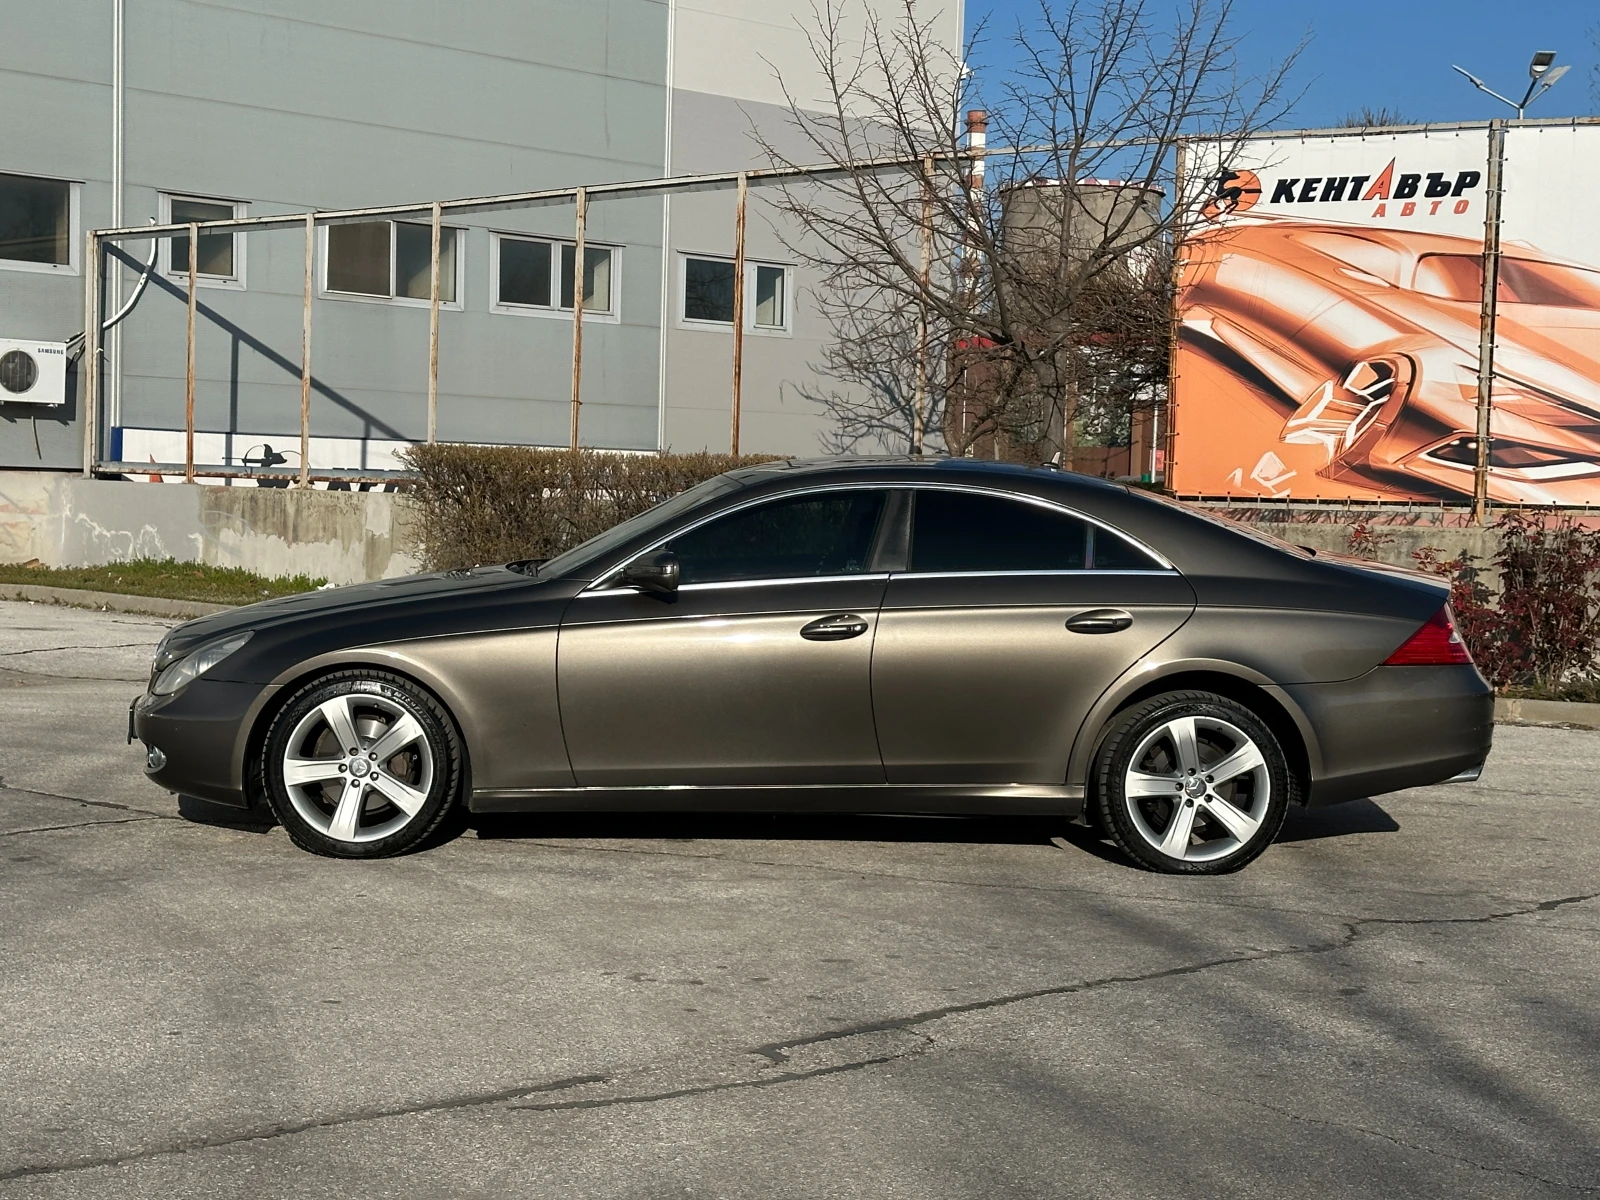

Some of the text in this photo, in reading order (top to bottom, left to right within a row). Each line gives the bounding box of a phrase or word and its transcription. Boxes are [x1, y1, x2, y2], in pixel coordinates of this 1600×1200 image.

[1269, 156, 1481, 204] КЕНТАВЪР
[1371, 199, 1470, 218] АВТО
[37, 347, 64, 355] SAMSUNG
